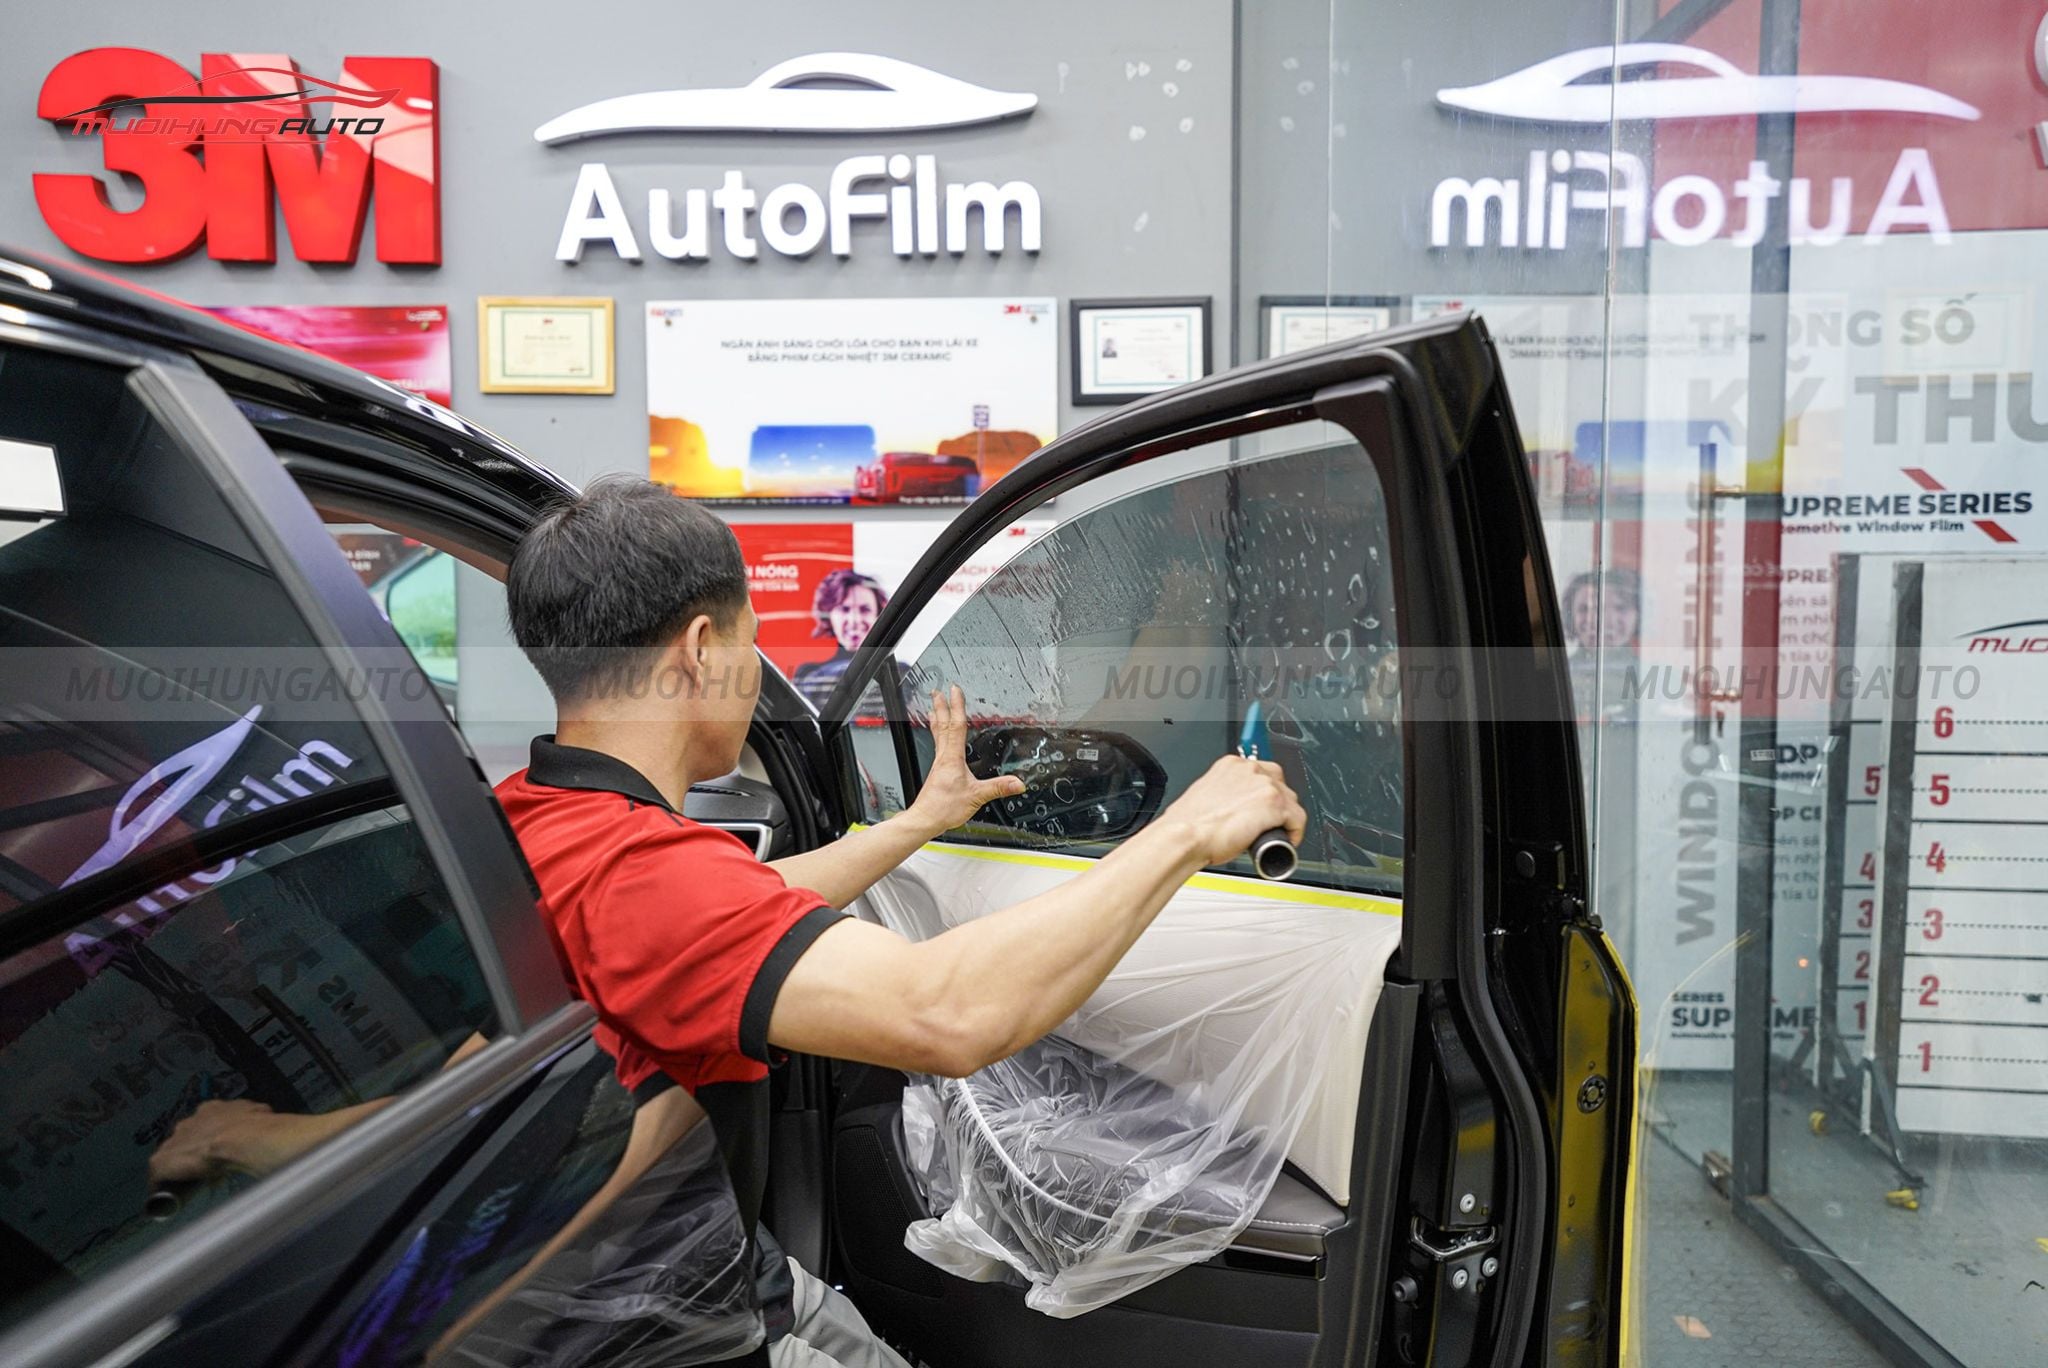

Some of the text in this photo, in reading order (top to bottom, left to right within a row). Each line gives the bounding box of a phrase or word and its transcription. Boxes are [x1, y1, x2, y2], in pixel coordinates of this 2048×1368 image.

[33, 47, 441, 267] 3M
[555, 154, 1042, 264] AutoFilm
[1899, 292, 1977, 345] SỐ
[1781, 491, 2033, 517] UPREME SERIES
[1933, 707, 1955, 738] 6
[1930, 775, 1951, 806] 5
[1926, 843, 1947, 873] 4
[1923, 909, 1944, 940] 3
[1854, 952, 1870, 980] 2
[1919, 975, 1941, 1007] 2
[1671, 1006, 1816, 1029] SUPME
[1854, 1003, 1868, 1031] 1
[1917, 1042, 1932, 1072] 1
